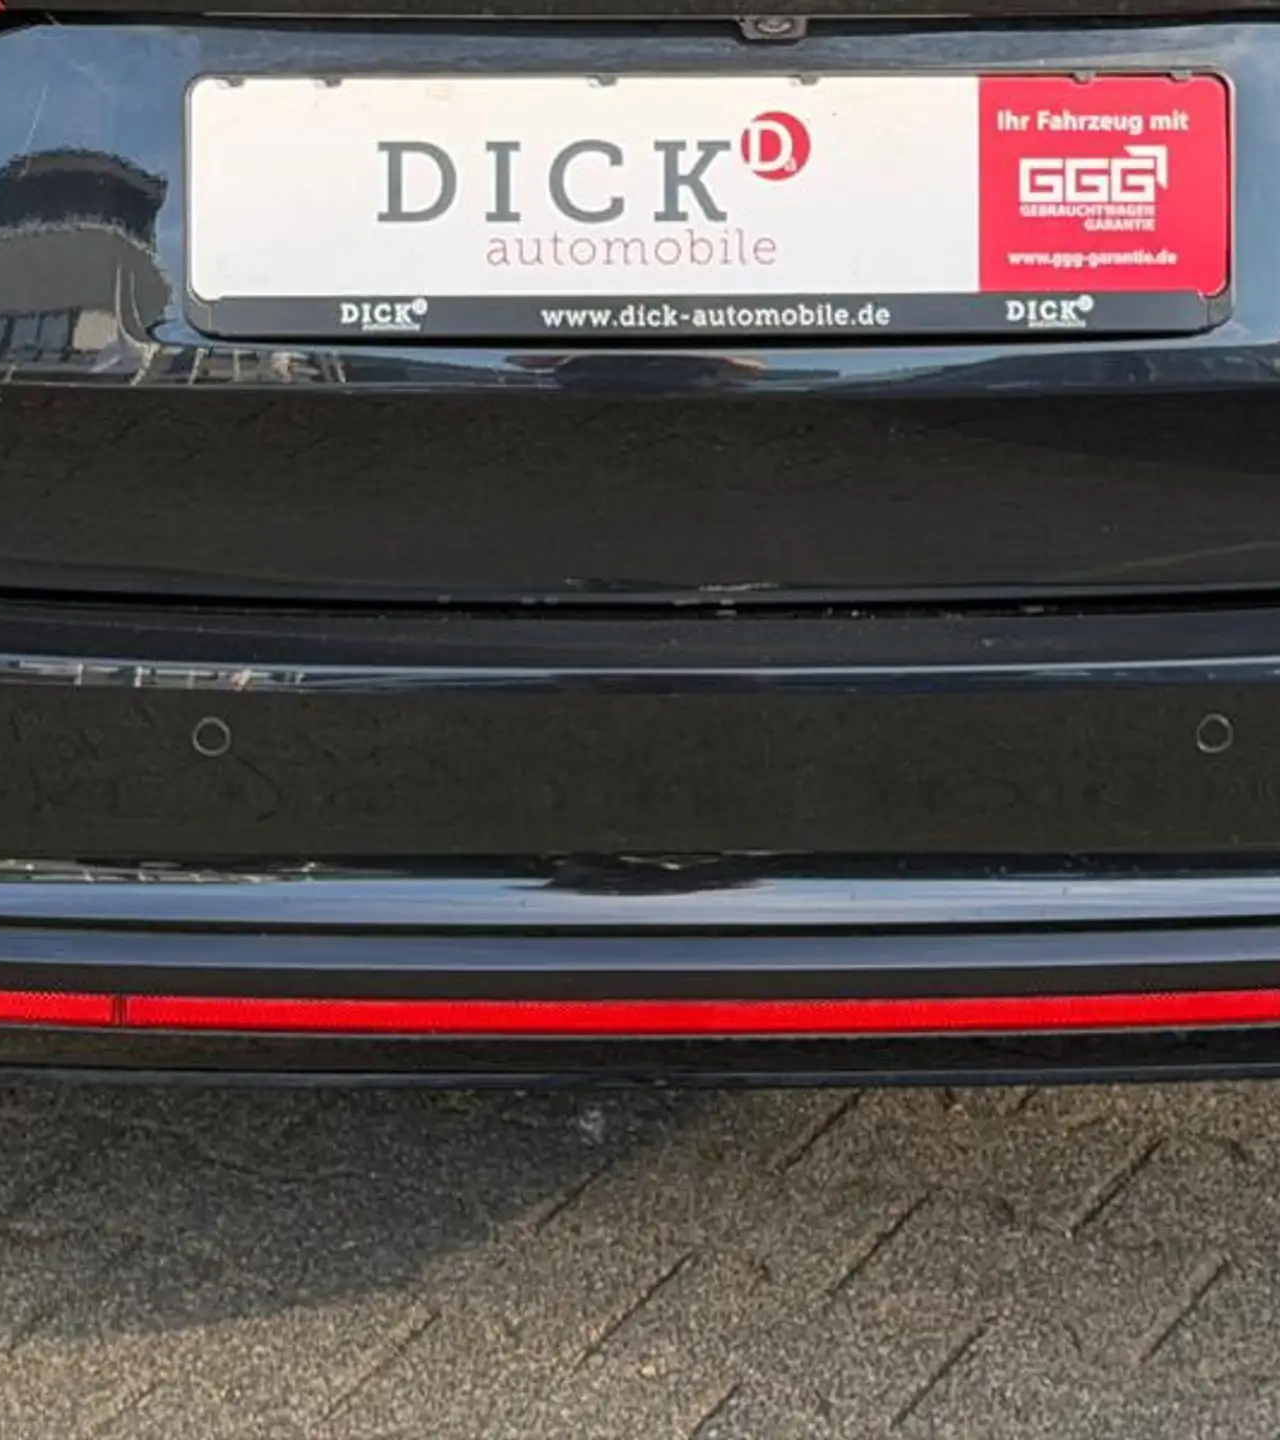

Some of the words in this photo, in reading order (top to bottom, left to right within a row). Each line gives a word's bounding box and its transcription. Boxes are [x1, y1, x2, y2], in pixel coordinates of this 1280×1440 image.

[997, 110, 1030, 131] Ihr
[1037, 109, 1144, 136] Fahrzeug
[1150, 109, 1189, 131] mit
[377, 139, 731, 224] DICK
[1019, 157, 1156, 203] GGG
[1020, 204, 1156, 217] GEBRAUCHTWAGEN
[1084, 218, 1156, 232] GARANTIE
[486, 229, 776, 266] automobile
[1008, 250, 1178, 268] www.ggg-garantie.de
[340, 303, 412, 324] DICK
[541, 304, 891, 327] www.dick-automobile.de
[1005, 300, 1079, 321] DICK
